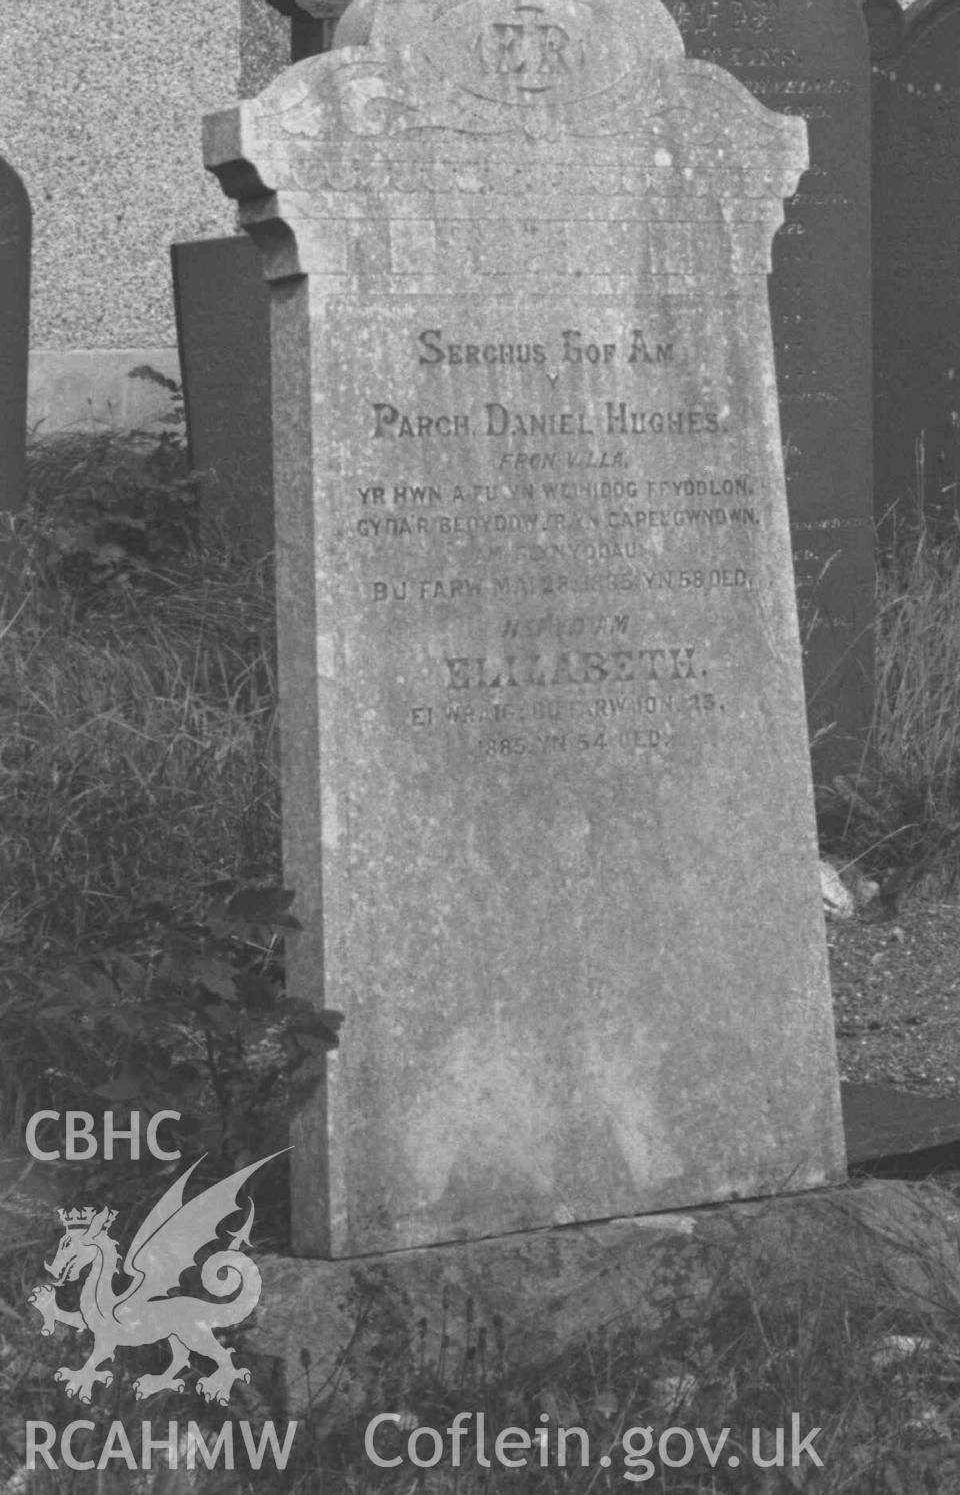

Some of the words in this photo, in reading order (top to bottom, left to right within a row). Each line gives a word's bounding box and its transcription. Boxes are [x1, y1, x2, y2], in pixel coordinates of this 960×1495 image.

[418, 328, 547, 365] SERCHUS
[628, 328, 675, 364] AM
[546, 374, 559, 390] Y
[484, 402, 594, 436] DANIEL
[357, 485, 386, 505] YR
[393, 485, 441, 504] HWN
[452, 484, 464, 502] A
[373, 581, 406, 602] BU
